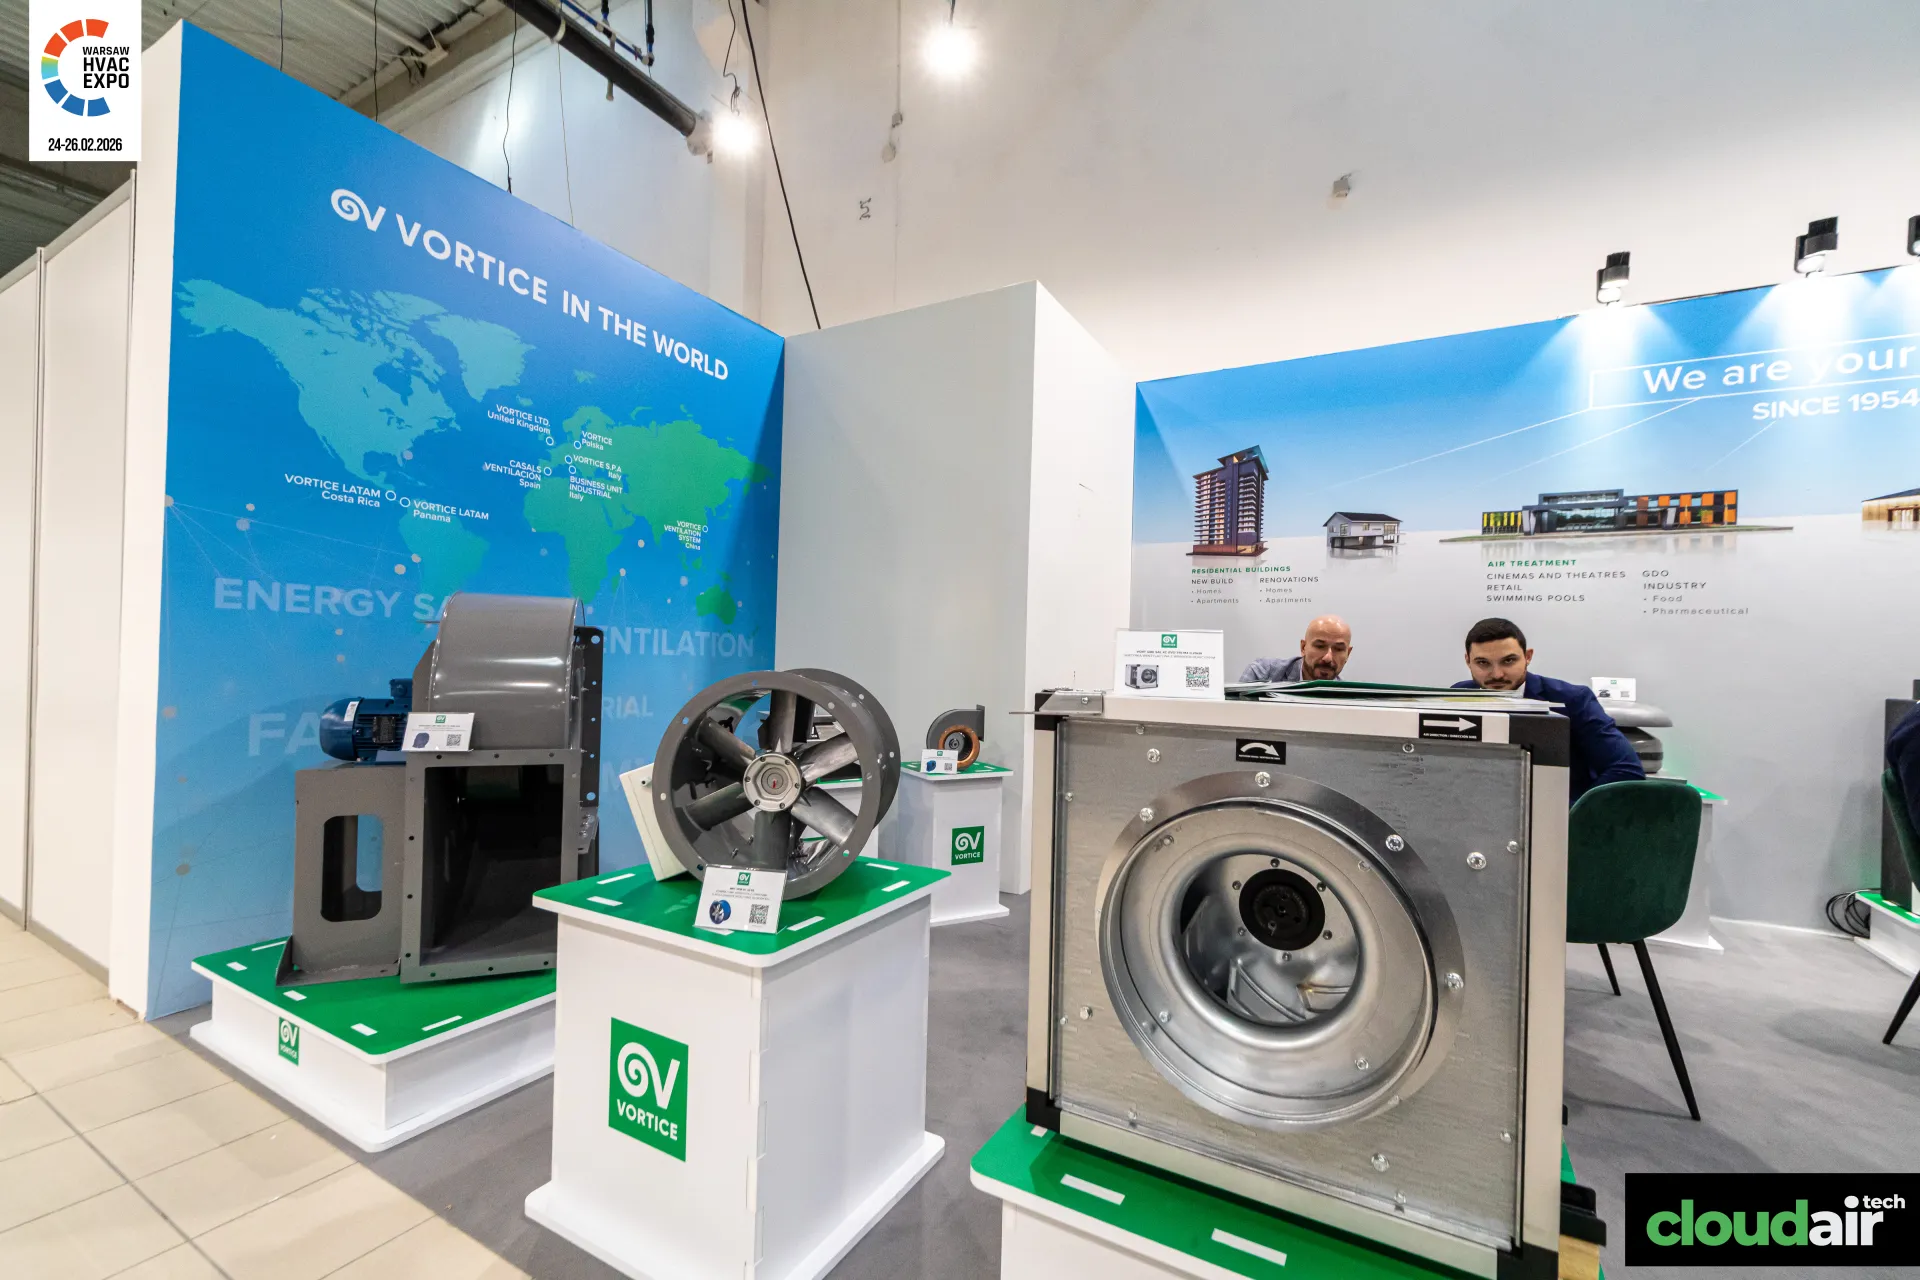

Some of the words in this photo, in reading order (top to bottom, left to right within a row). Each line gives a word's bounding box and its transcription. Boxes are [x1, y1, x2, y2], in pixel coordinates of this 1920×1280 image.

[395, 213, 548, 305] VORTICE
[562, 289, 590, 324] IN
[598, 305, 647, 348] THE
[652, 330, 729, 381] WORLD
[1643, 366, 1707, 394] We
[1722, 359, 1793, 387] are
[1809, 345, 1918, 384] your
[1752, 395, 1841, 421] SINCE
[1848, 388, 1920, 413] 1954
[496, 404, 533, 422] VORTICE
[534, 415, 551, 427] LTD.
[487, 410, 515, 425] United
[516, 416, 551, 435] Kingdom
[581, 430, 613, 446] VORTICE
[581, 439, 604, 451] Polska
[509, 459, 542, 474] CASALS
[573, 454, 604, 469] VORTICE
[608, 471, 622, 481] Italy
[284, 473, 339, 491] VORTICE
[342, 484, 381, 498] LATAM
[519, 479, 541, 490] Spain
[569, 475, 605, 490] BUSINESS
[606, 484, 623, 494] UNIT
[569, 484, 612, 499] INDUSTRIAL
[569, 491, 584, 502] Italy
[321, 490, 354, 504] Costa
[357, 496, 381, 508] Rica
[413, 500, 457, 515] VORTICE
[458, 508, 489, 521] LATAM
[413, 509, 451, 523] Panama
[664, 524, 701, 537] VENTILATION
[676, 520, 702, 531] VORTICE
[678, 534, 702, 544] SYSTEM
[1487, 560, 1506, 568] AIR
[1511, 558, 1577, 567] TREATMENT
[1191, 567, 1243, 575] RESIDENTIAL
[1245, 565, 1291, 573] BUILDINGS
[1486, 572, 1535, 580] CINEMAS
[1538, 571, 1562, 580] AND
[1566, 570, 1627, 579] THEATRES
[1642, 570, 1670, 578] GDO
[1259, 576, 1320, 584] RENOVATIONS
[1643, 582, 1707, 590] INDUSTRY
[214, 577, 403, 618] ENERGY
[1486, 594, 1543, 602] SWIMMING
[1547, 594, 1586, 602] POOLS
[1652, 594, 1684, 603] Food
[1652, 607, 1749, 615] Pharmaceutical
[954, 851, 981, 860] VORTICE
[616, 1098, 679, 1141] VORTICE
